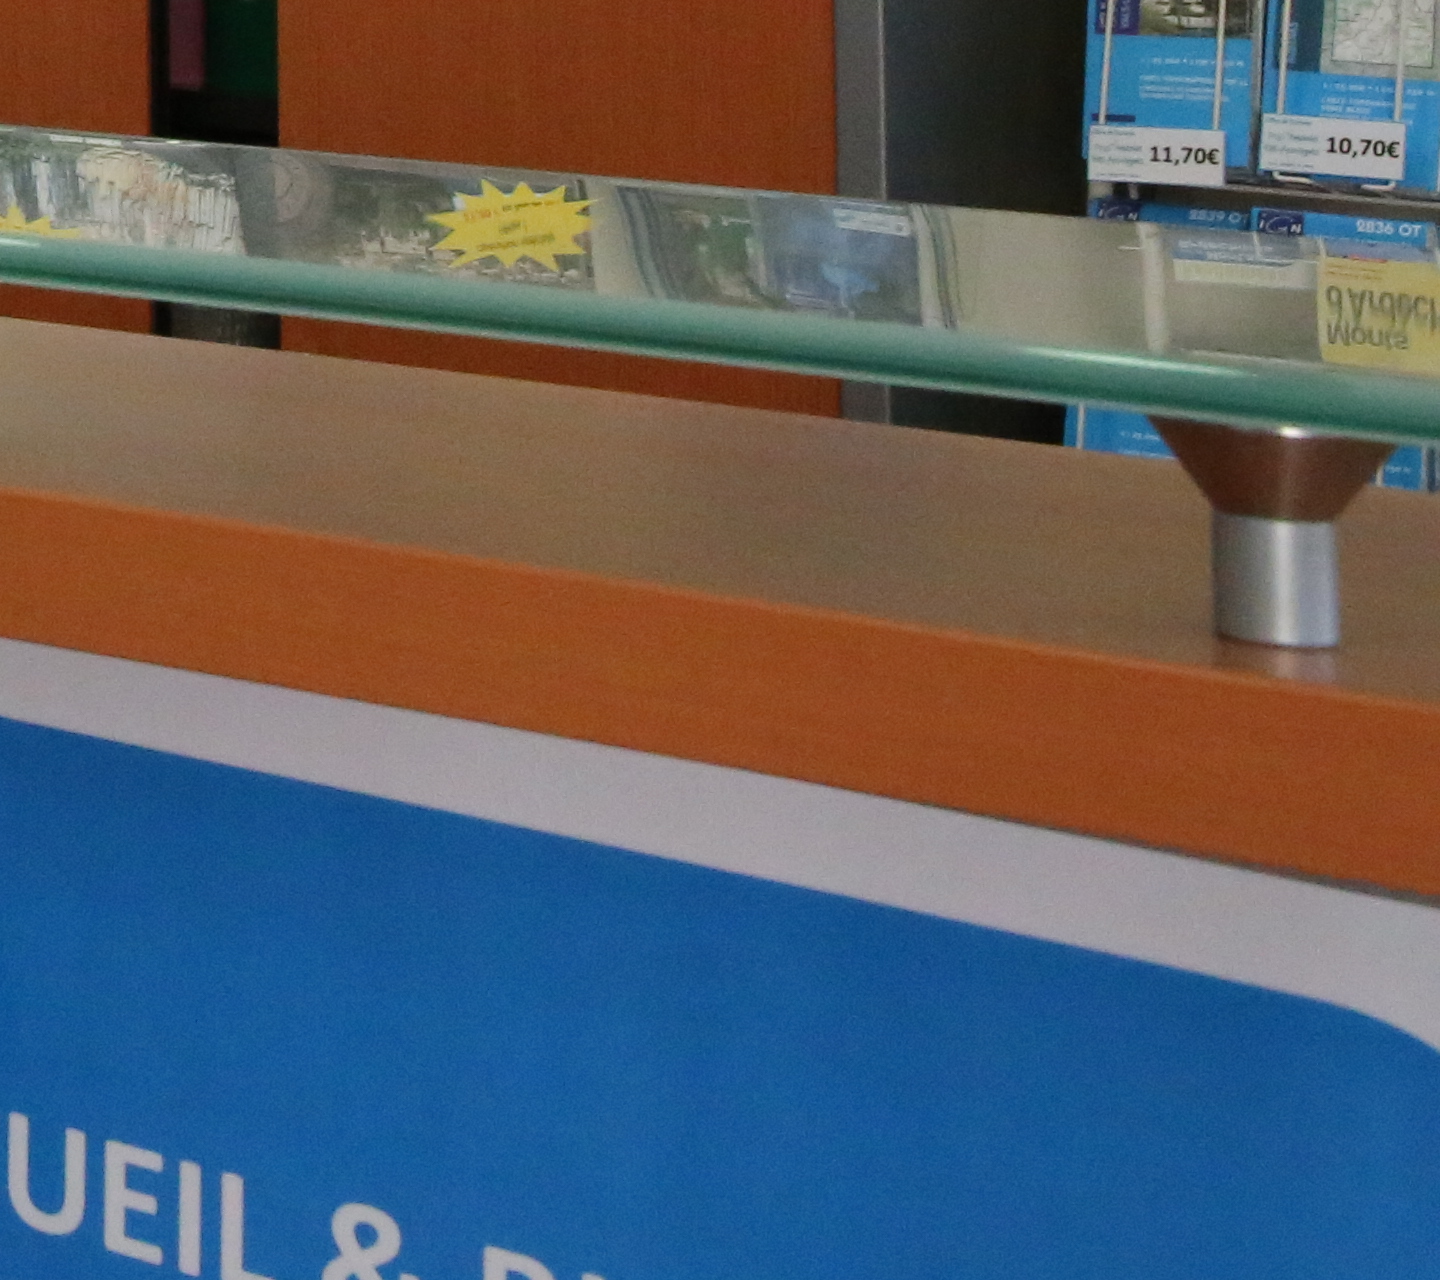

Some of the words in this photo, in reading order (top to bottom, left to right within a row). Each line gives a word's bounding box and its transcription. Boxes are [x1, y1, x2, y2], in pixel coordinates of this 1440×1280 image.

[1149, 145, 1220, 166] 11,70€
[1325, 136, 1401, 159] 10,70€
[1397, 222, 1422, 237] OT
